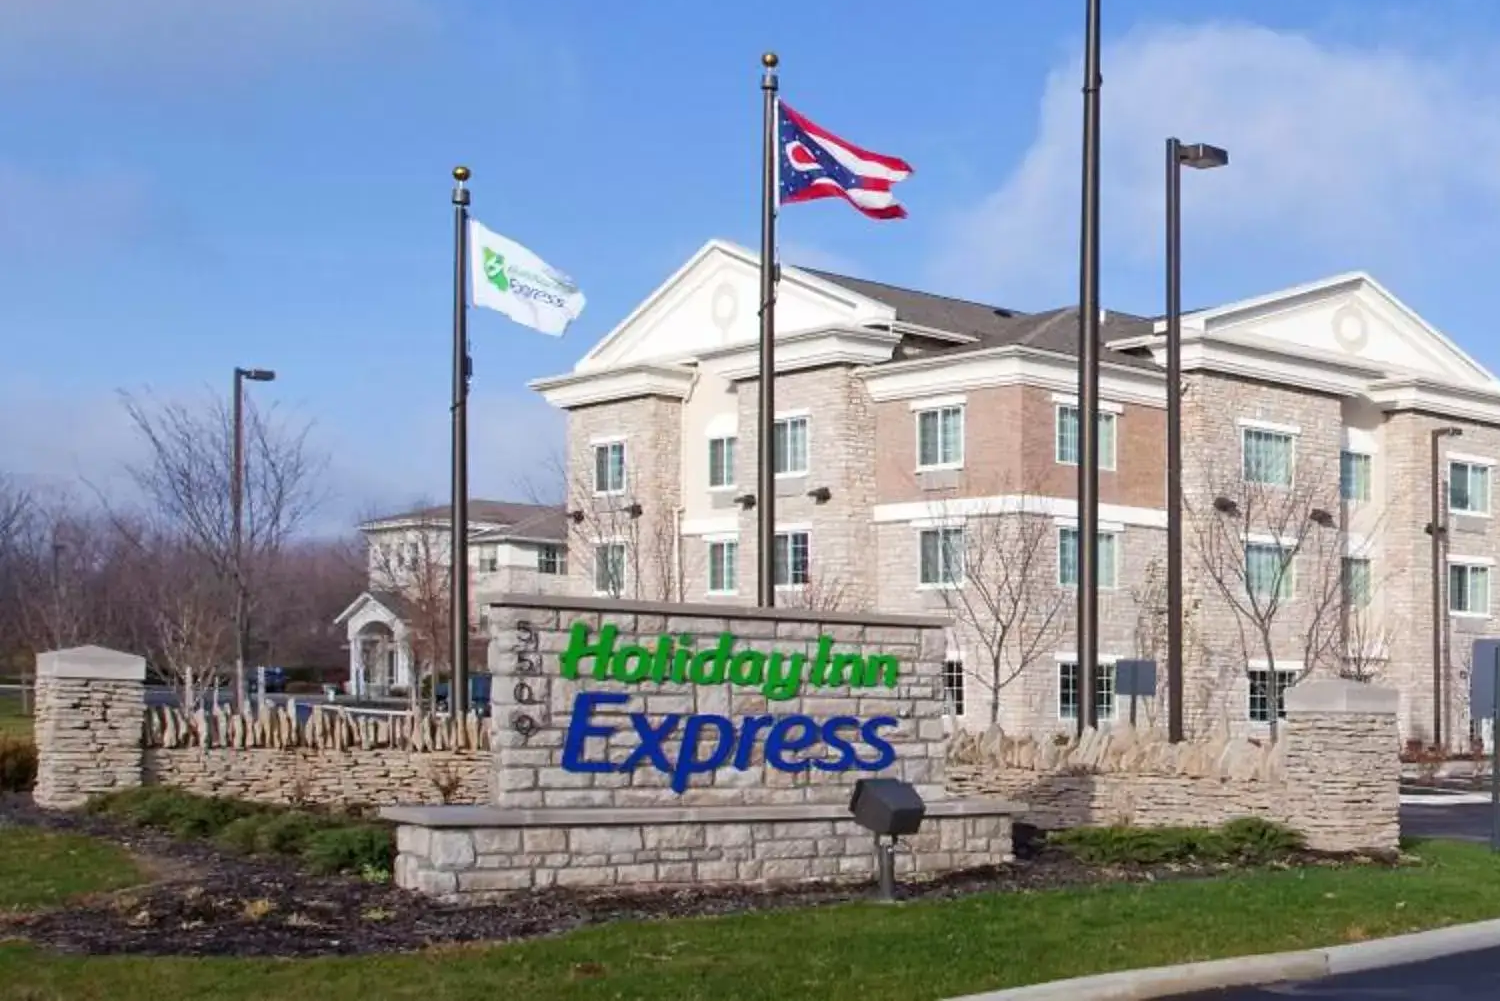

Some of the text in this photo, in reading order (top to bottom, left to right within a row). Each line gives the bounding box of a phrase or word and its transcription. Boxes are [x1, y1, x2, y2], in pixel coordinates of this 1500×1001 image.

[559, 621, 899, 700] Holiday Inn
[561, 691, 898, 794] Express
